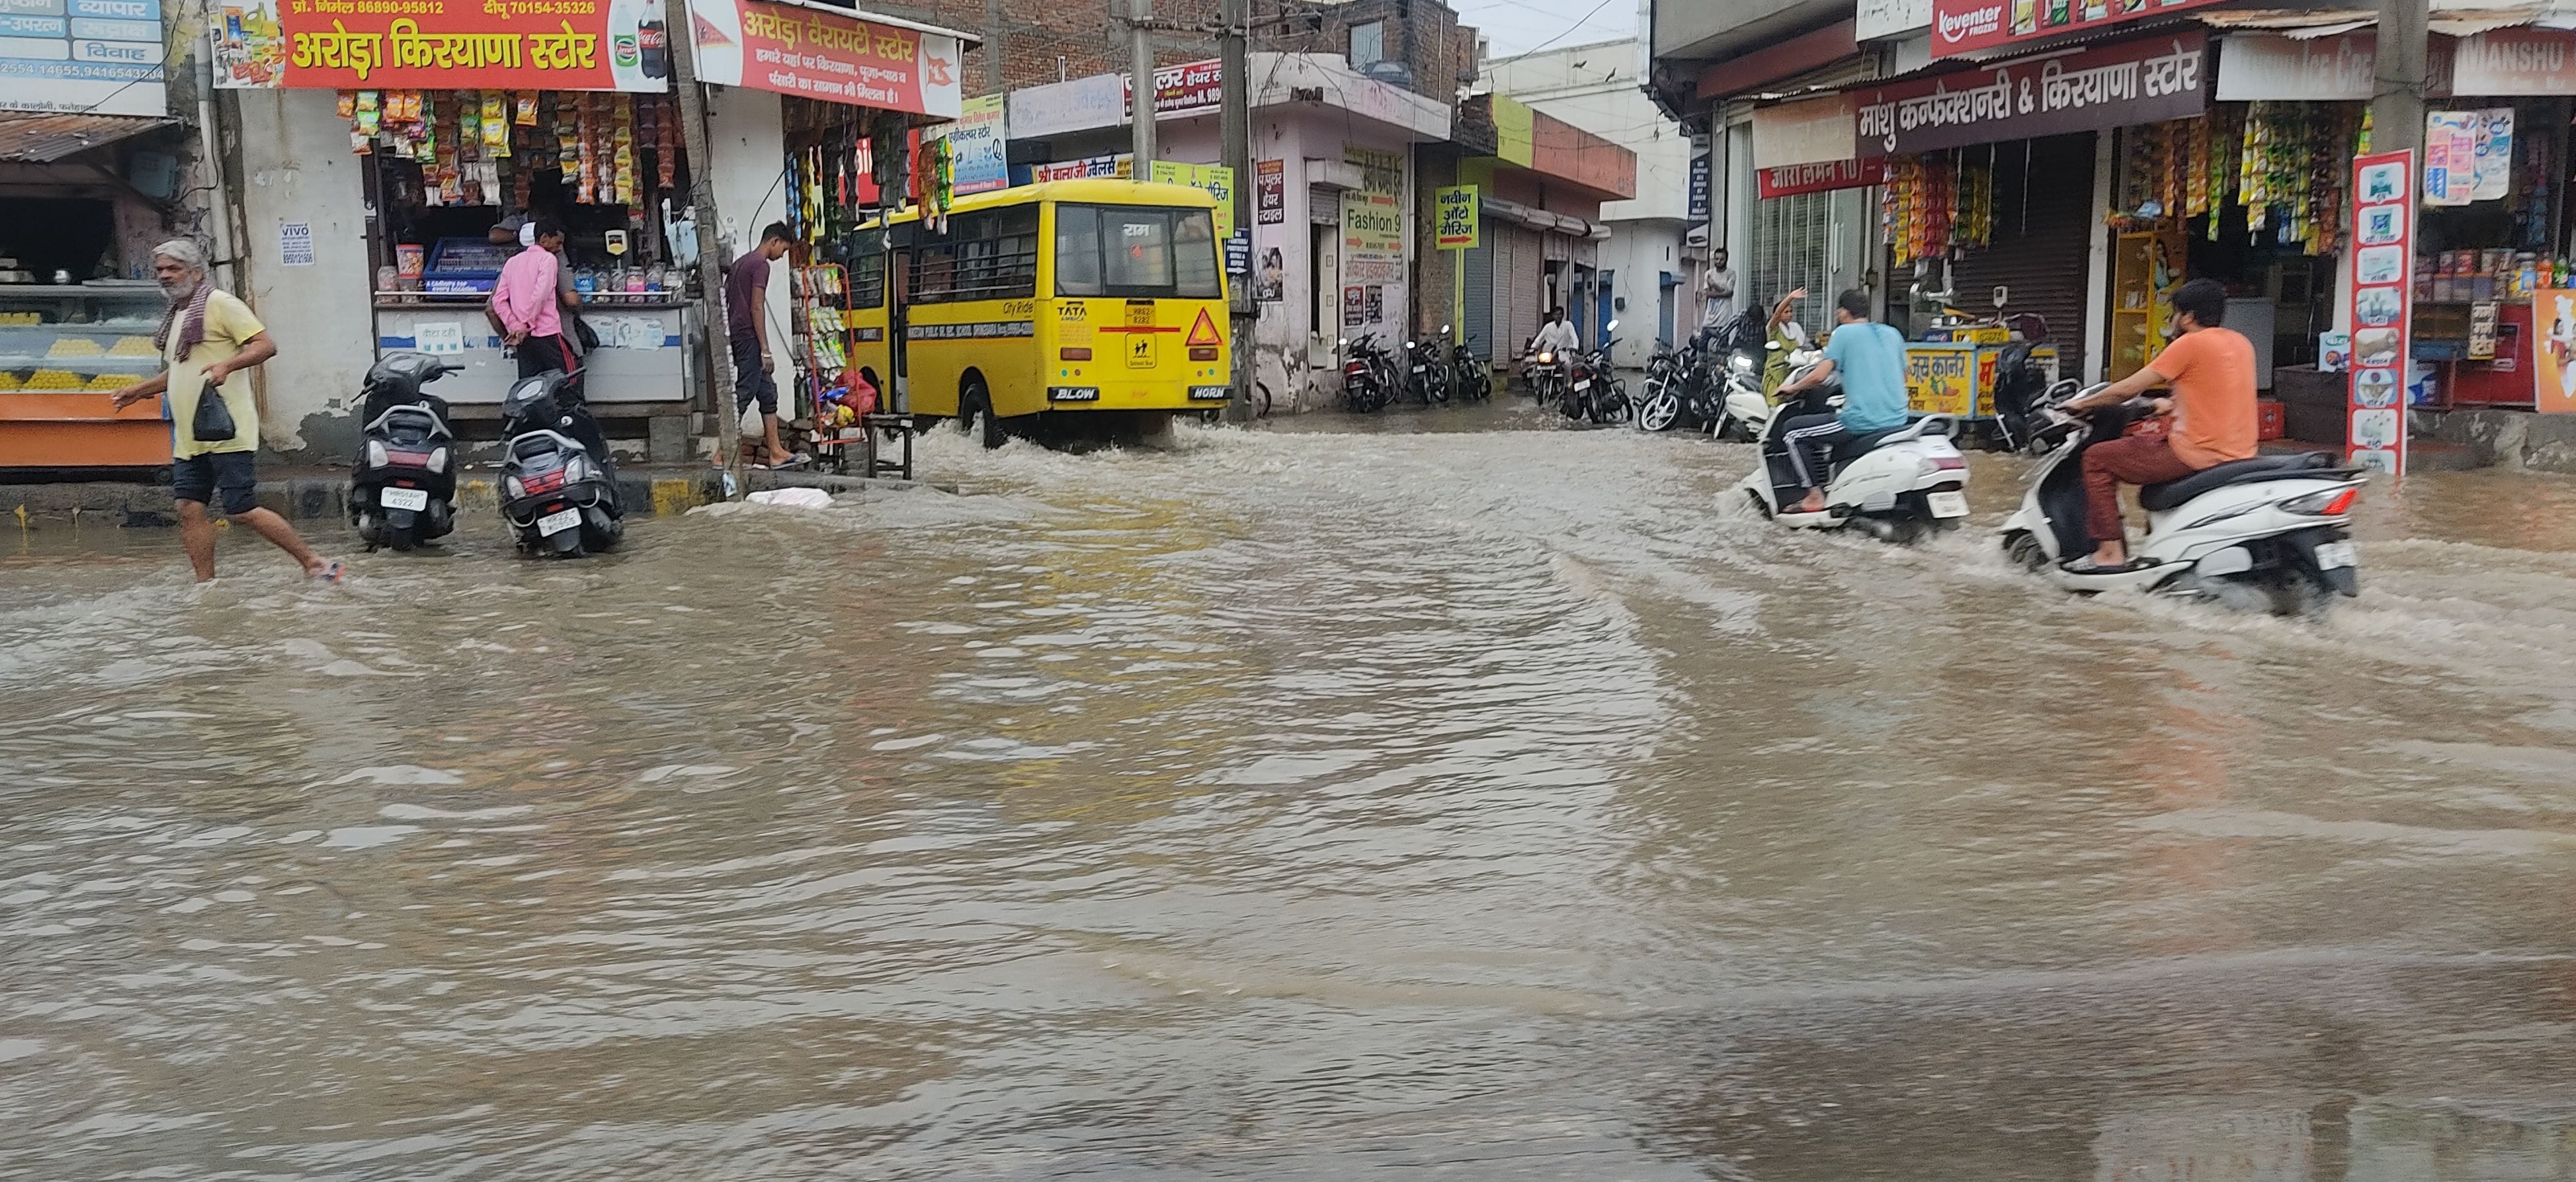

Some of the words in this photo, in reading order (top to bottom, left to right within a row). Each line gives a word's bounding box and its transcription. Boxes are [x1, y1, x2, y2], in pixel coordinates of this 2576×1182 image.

[78, 1, 149, 16] व्यापार
[357, 1, 444, 14] 86890-95812
[510, 1, 595, 15] 70154-35326
[0, 18, 62, 32] -उपरत्न
[1968, 22, 1998, 37] FROZEN
[744, 5, 802, 50] अरोड़ा
[807, 13, 870, 56] वैरायटी
[875, 29, 914, 63] स्टोर
[85, 42, 147, 60] विवाह
[291, 19, 384, 81] अरोड़ा
[390, 18, 522, 69] किरयाणा
[528, 19, 597, 69] स्टोर
[802, 56, 816, 69] पर
[798, 77, 811, 91] का
[844, 81, 856, 97] भी
[1198, 90, 1206, 104] M.
[1858, 91, 1897, 153] मांशु
[1899, 67, 2012, 131] कन्फैक्शनरी
[2018, 73, 2034, 115] &
[2041, 60, 2139, 112] किरयाणा
[2143, 40, 2202, 98] स्टोर
[977, 123, 991, 141] स्टोर
[1440, 190, 1472, 204] नवीन
[1348, 208, 1392, 232] Fashion
[1395, 214, 1401, 232] 9
[1123, 224, 1150, 236] राम
[1057, 306, 1087, 316] TATA
[1056, 388, 1095, 400] BLOW
[1194, 387, 1225, 399] HORN
